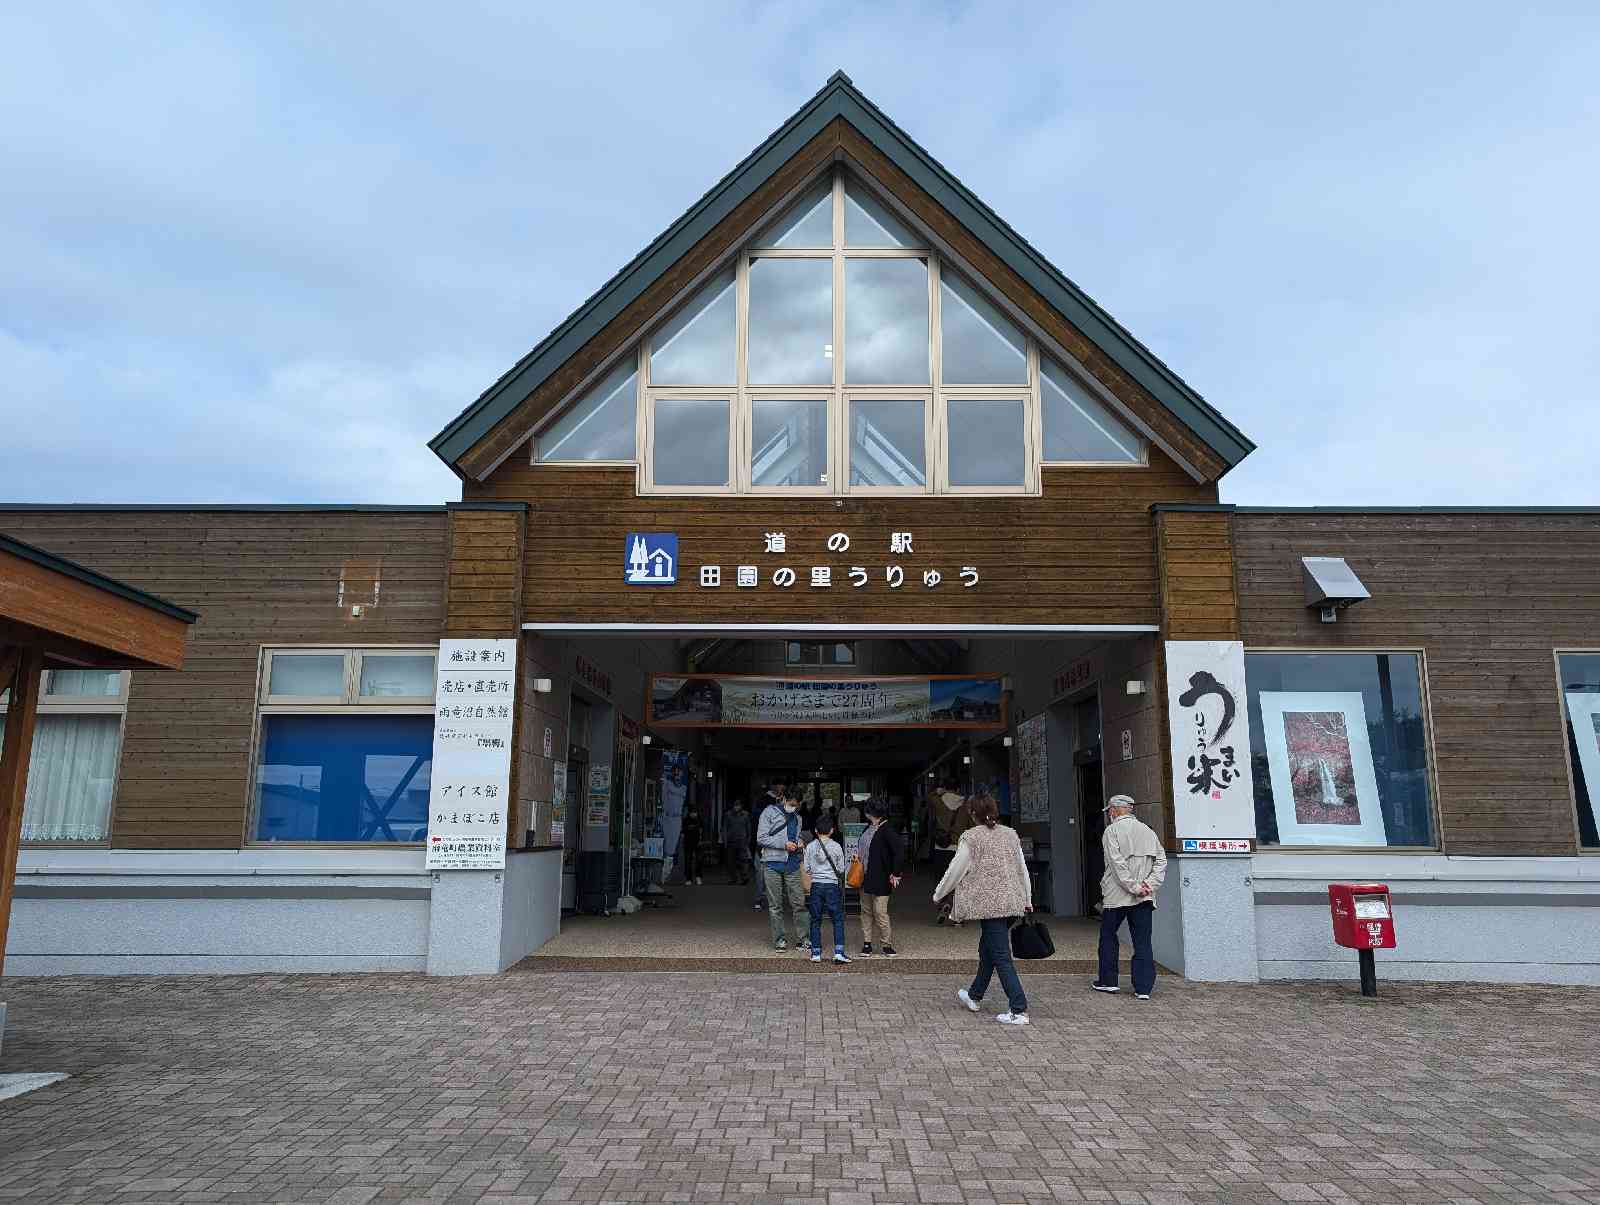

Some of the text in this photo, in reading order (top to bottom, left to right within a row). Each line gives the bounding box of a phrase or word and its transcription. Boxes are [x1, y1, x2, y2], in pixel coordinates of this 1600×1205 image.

[764, 533, 913, 553] 道の駅
[701, 566, 979, 587] 田園の里うりゅう
[450, 650, 506, 663] 施設案内
[441, 680, 511, 693] 売店・直売所
[440, 784, 499, 798] アイス館
[436, 812, 501, 825] かまぼこ店
